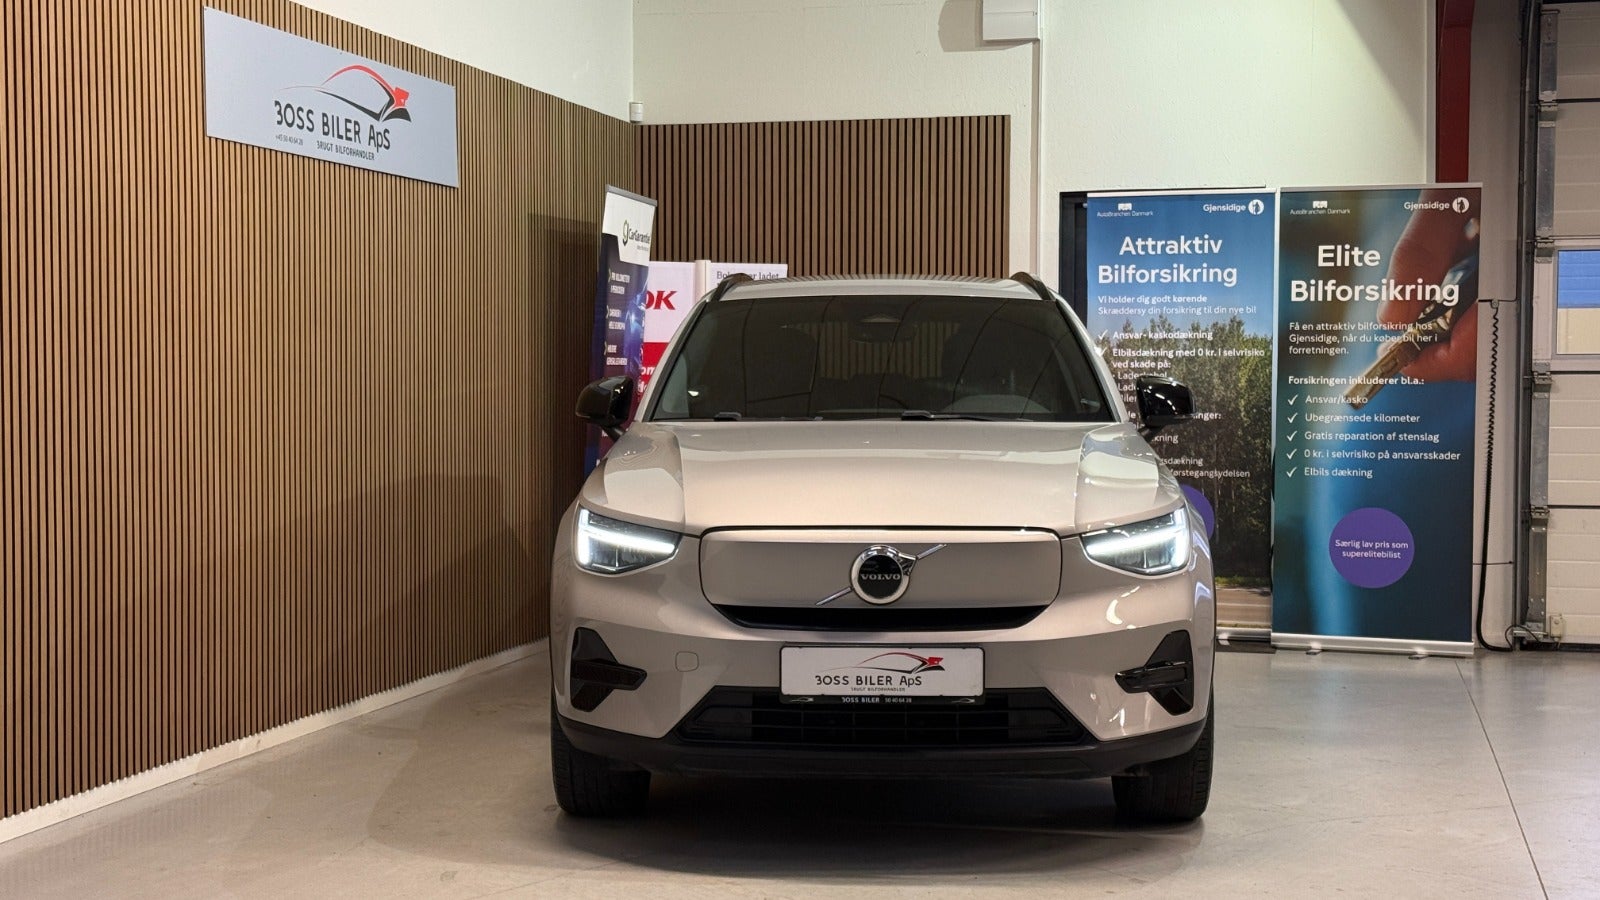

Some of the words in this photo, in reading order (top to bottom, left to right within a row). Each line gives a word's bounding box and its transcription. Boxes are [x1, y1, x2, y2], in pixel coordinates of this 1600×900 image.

[322, 112, 362, 144] BILER
[368, 124, 391, 153] ApS
[335, 145, 375, 160] BILFORHANDLER
[1203, 203, 1246, 213] Gjensidige
[1404, 201, 1450, 211] Gjensidige
[1119, 234, 1222, 256] Attraktiv
[1318, 244, 1381, 267] Elite
[1098, 264, 1238, 288] Bilforsikring
[1290, 278, 1460, 306] Bilforsikring
[1136, 295, 1150, 305] dig
[1152, 295, 1171, 304] godt
[1172, 295, 1208, 303] kørende
[1098, 306, 1146, 316] Skræddersy
[1148, 306, 1161, 314] din
[1162, 305, 1202, 315] forsikring
[1204, 305, 1212, 314] til
[1214, 305, 1227, 314] din
[1228, 306, 1244, 315] nye
[1246, 305, 1257, 314] bil
[1289, 322, 1300, 330] Få
[1316, 322, 1355, 330] attraktiv
[1357, 322, 1413, 332] bilforsikring
[1415, 322, 1432, 330] hos
[1148, 331, 1213, 341] kaskodækning
[1289, 334, 1339, 344] Gjensidige,
[1342, 334, 1357, 342] når
[1359, 334, 1372, 342] du
[1374, 334, 1400, 342] køber
[1402, 334, 1414, 342] bil
[1416, 334, 1432, 342] her
[1112, 349, 1174, 358] Elbilsdækning
[1176, 348, 1196, 357] med
[1205, 348, 1217, 357] kr.
[1223, 349, 1265, 357] selvrisiko
[1289, 346, 1349, 355] forretningen.
[1112, 360, 1129, 368] ved
[1130, 360, 1155, 368] skade
[1158, 359, 1171, 370] på:
[1288, 375, 1346, 387] Forsikringen
[1349, 376, 1398, 385] inkluderer
[1305, 395, 1368, 405] Ansvar/kasko
[1305, 414, 1371, 424] Ubegrænsede
[1374, 414, 1421, 423] kilometer
[1304, 432, 1333, 440] Gratis
[1335, 432, 1384, 442] reparation
[1386, 432, 1396, 440] af
[1398, 432, 1440, 443] stenslag
[1304, 450, 1311, 458] 0
[1312, 450, 1324, 458] kr.
[1331, 450, 1375, 459] selvrisiko
[1378, 450, 1390, 462] på
[1392, 451, 1461, 461] ansvarsskader
[1304, 467, 1329, 476] Elbils
[1332, 468, 1373, 479] dækning
[1335, 540, 1361, 549] Særlig
[1375, 541, 1390, 550] pris
[1342, 551, 1401, 559] superelitebilist
[856, 675, 893, 686] BILER
[900, 675, 922, 687] ApS
